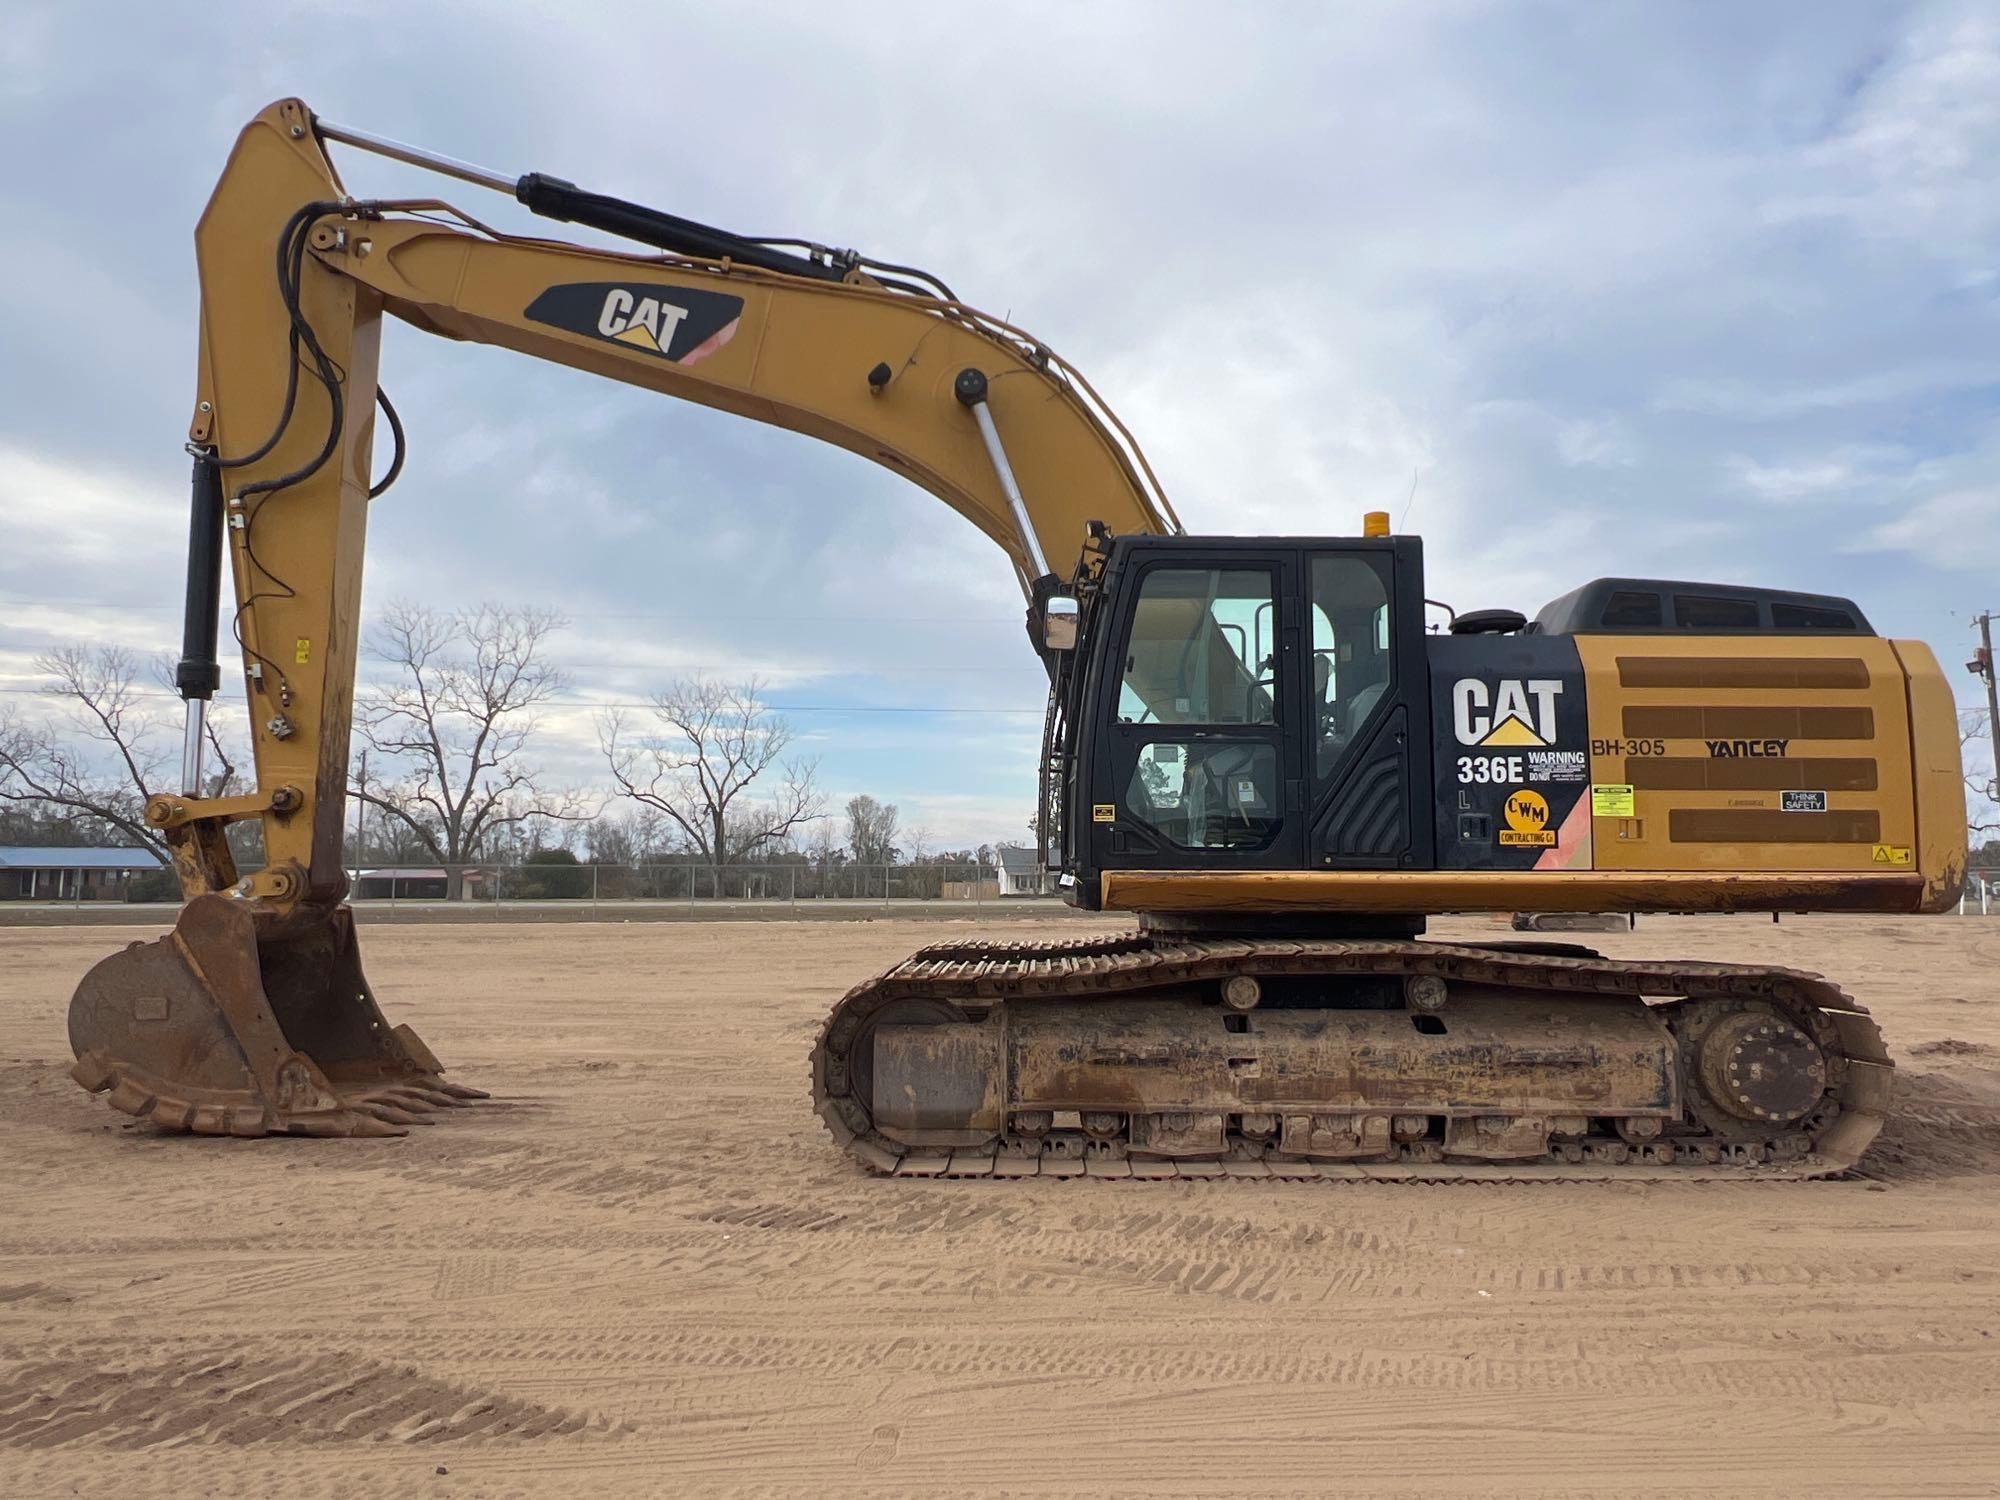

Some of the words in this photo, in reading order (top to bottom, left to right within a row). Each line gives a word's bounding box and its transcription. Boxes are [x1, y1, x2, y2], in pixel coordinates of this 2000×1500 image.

[598, 289, 688, 354] CAT
[1453, 679, 1563, 746] CAT
[1592, 740, 1665, 756] BH-305
[1705, 740, 1789, 758] YANCEY
[1528, 752, 1585, 764] WARNING
[1457, 756, 1524, 783] 336E
[1786, 801, 1822, 809] SAFETY
[1790, 793, 1817, 801] THINK
[1508, 798, 1545, 822] CWM
[1501, 832, 1545, 843] CONTRACTING
